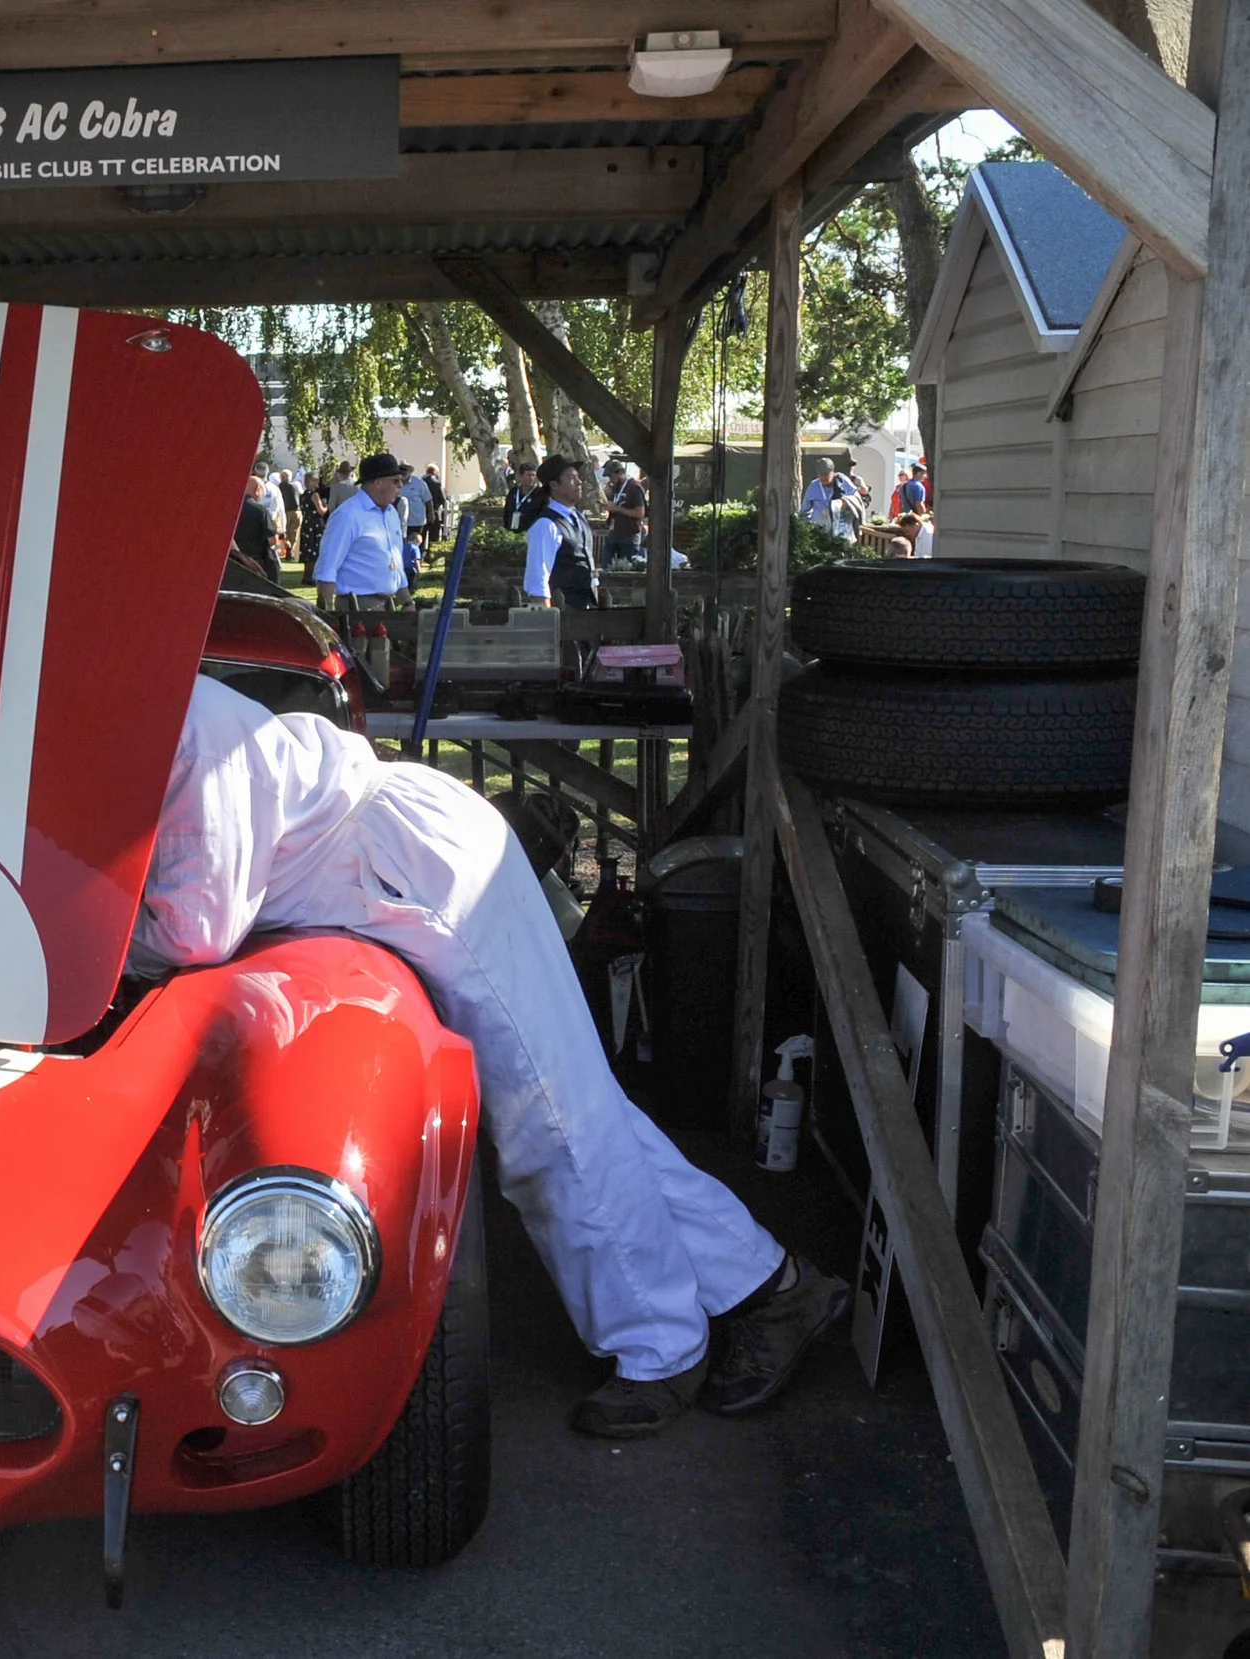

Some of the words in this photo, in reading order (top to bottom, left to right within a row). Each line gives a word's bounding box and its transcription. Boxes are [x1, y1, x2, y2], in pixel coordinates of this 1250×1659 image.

[16, 102, 68, 144] AC
[79, 97, 178, 140] Cobra
[37, 160, 93, 178] CLUB
[98, 158, 126, 176] TT
[131, 154, 281, 176] CELEBRATION
